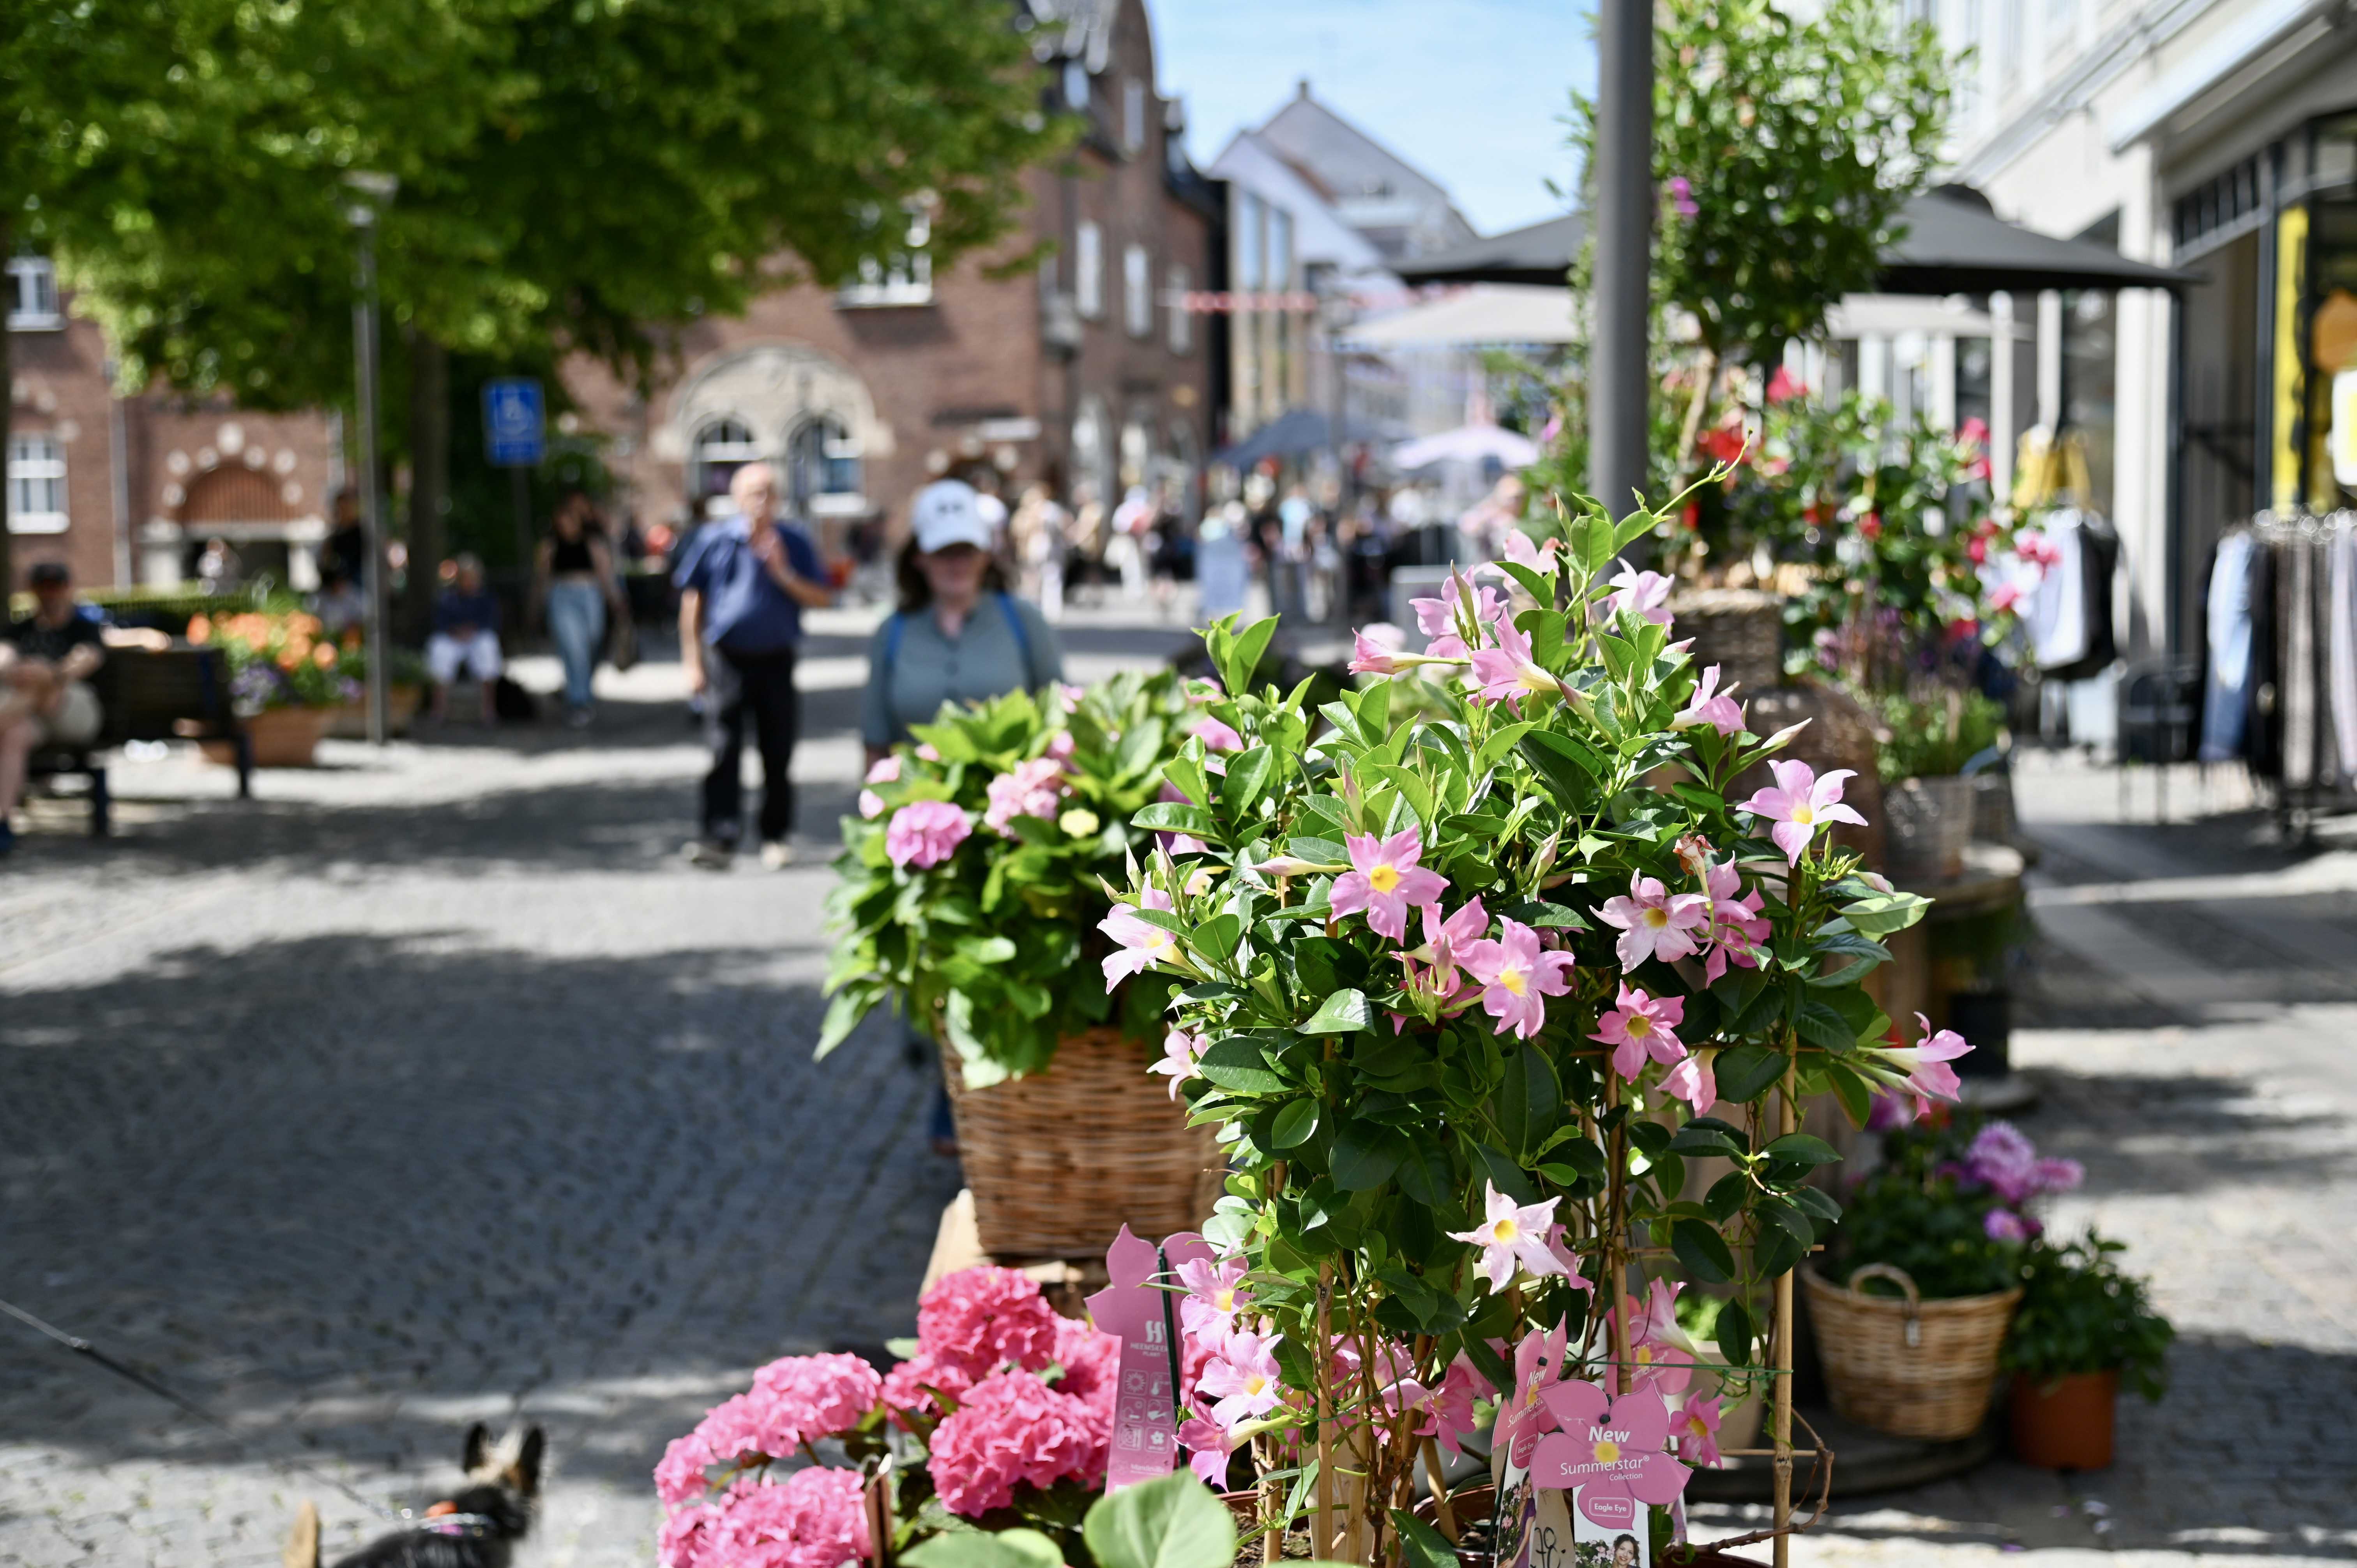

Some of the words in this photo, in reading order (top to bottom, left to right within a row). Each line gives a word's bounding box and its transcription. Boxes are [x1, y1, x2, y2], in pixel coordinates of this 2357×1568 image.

[1527, 1368, 1547, 1387] New
[1588, 1426, 1630, 1442] New
[1609, 1473, 1643, 1481] Collection
[1594, 1503, 1613, 1512] Eagle
[1615, 1504, 1627, 1513] Eye
